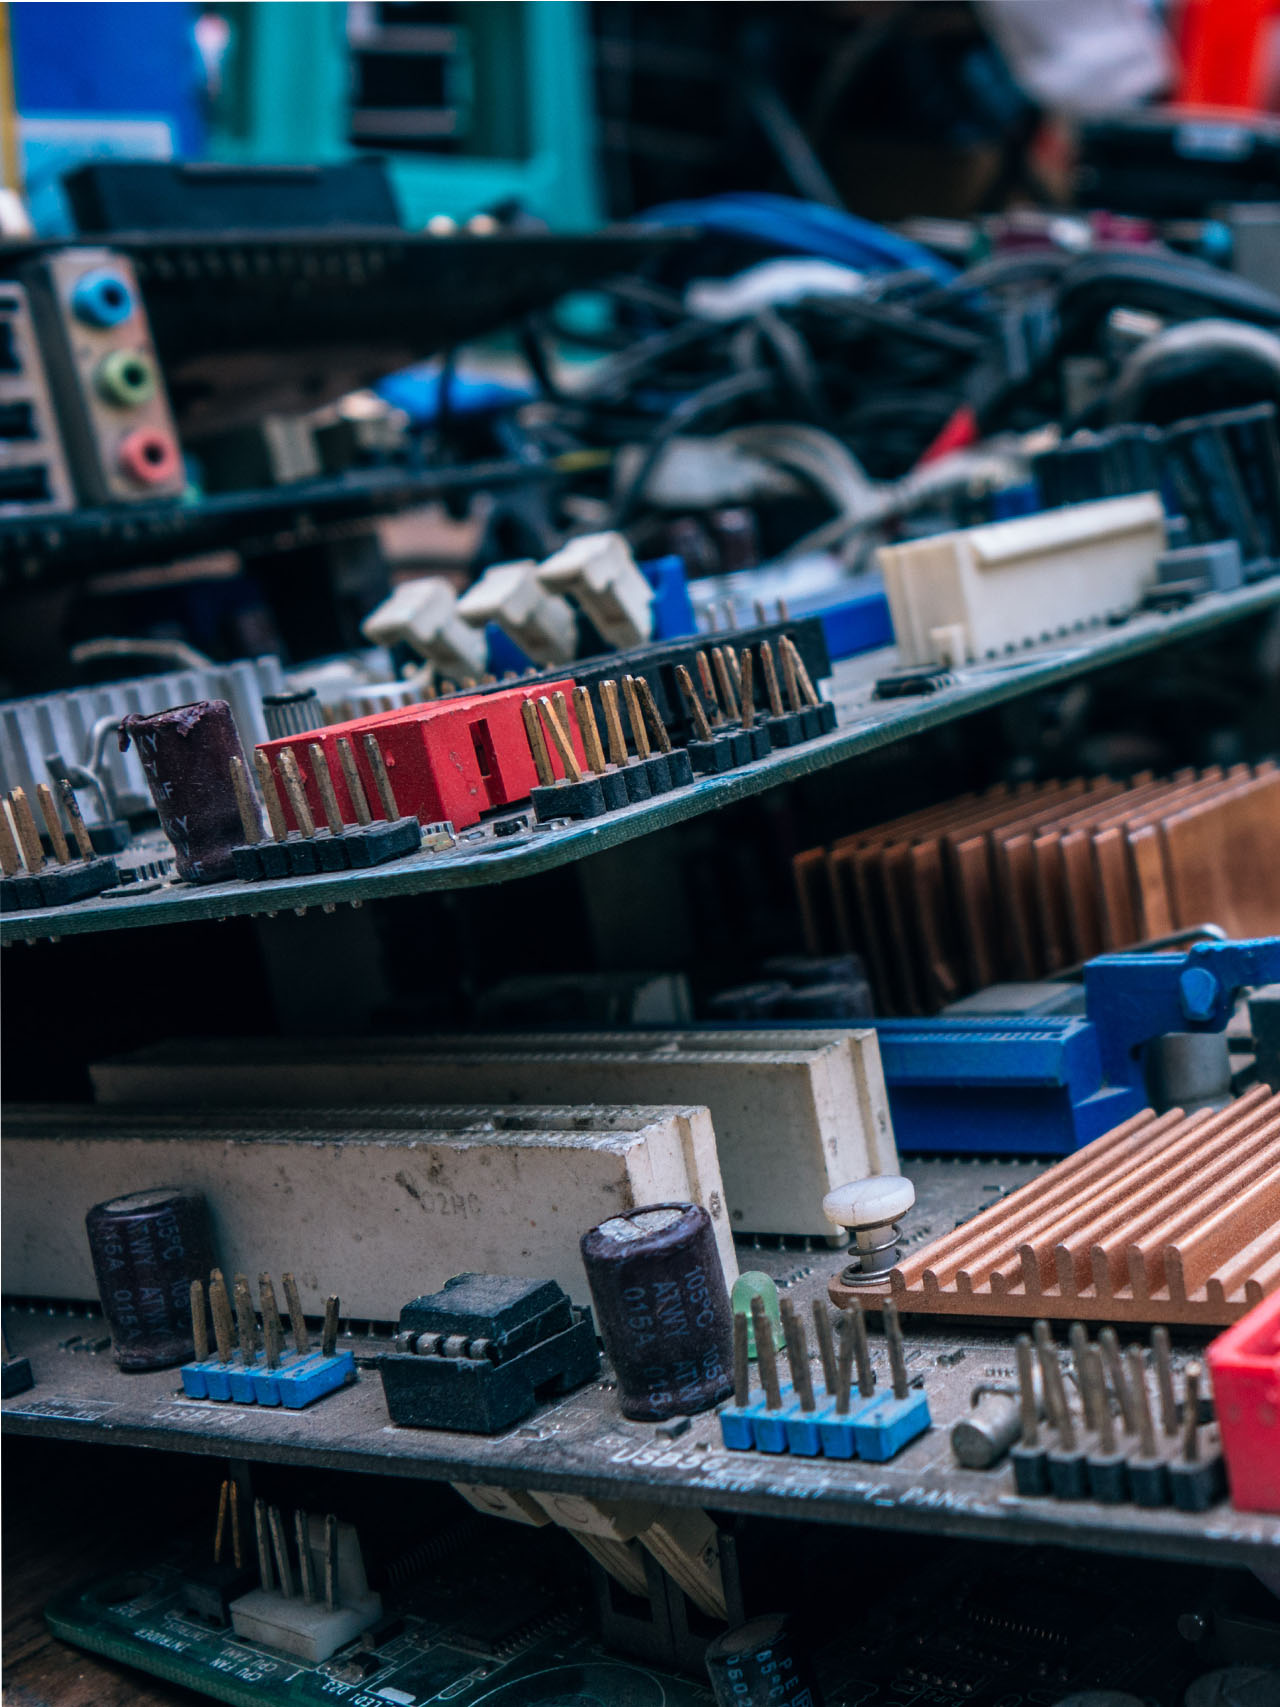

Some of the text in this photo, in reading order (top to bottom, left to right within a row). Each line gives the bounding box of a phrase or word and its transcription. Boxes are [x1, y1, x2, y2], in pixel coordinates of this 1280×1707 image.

[623, 1286, 657, 1348] 015A
[652, 1281, 690, 1338] ATWY
[684, 1265, 715, 1329] 105°C
[207, 1657, 262, 1681] CPU FAN
